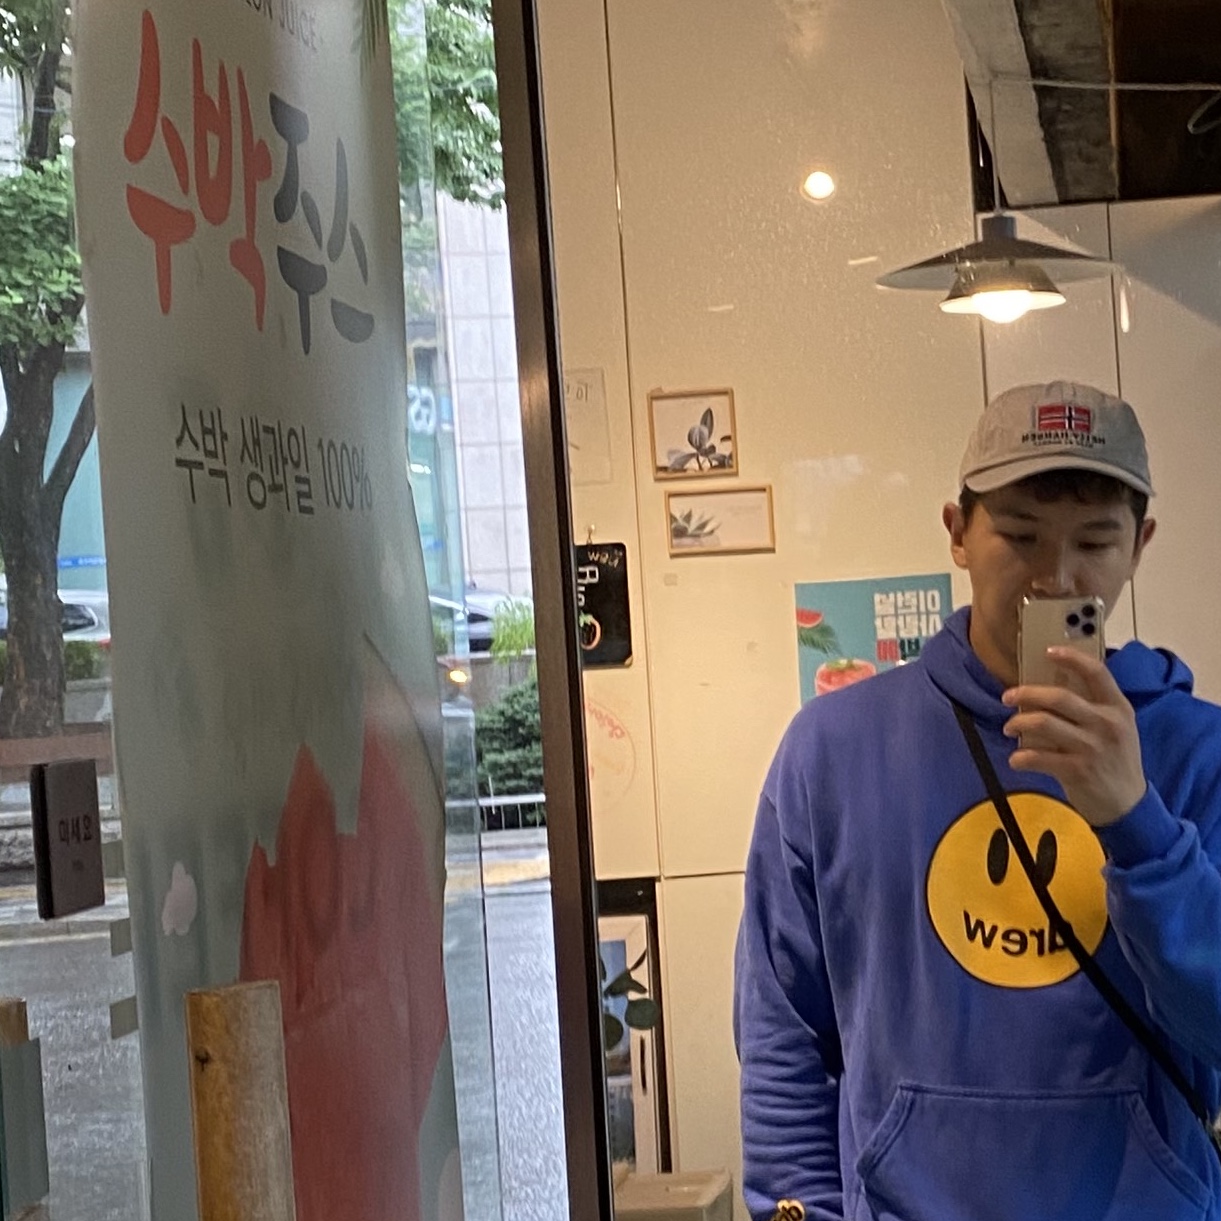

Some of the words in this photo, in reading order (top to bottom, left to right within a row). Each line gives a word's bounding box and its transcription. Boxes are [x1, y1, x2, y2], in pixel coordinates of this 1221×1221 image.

[174, 402, 233, 508] 수박
[239, 414, 316, 516] 생과일
[316, 436, 374, 512] 100%
